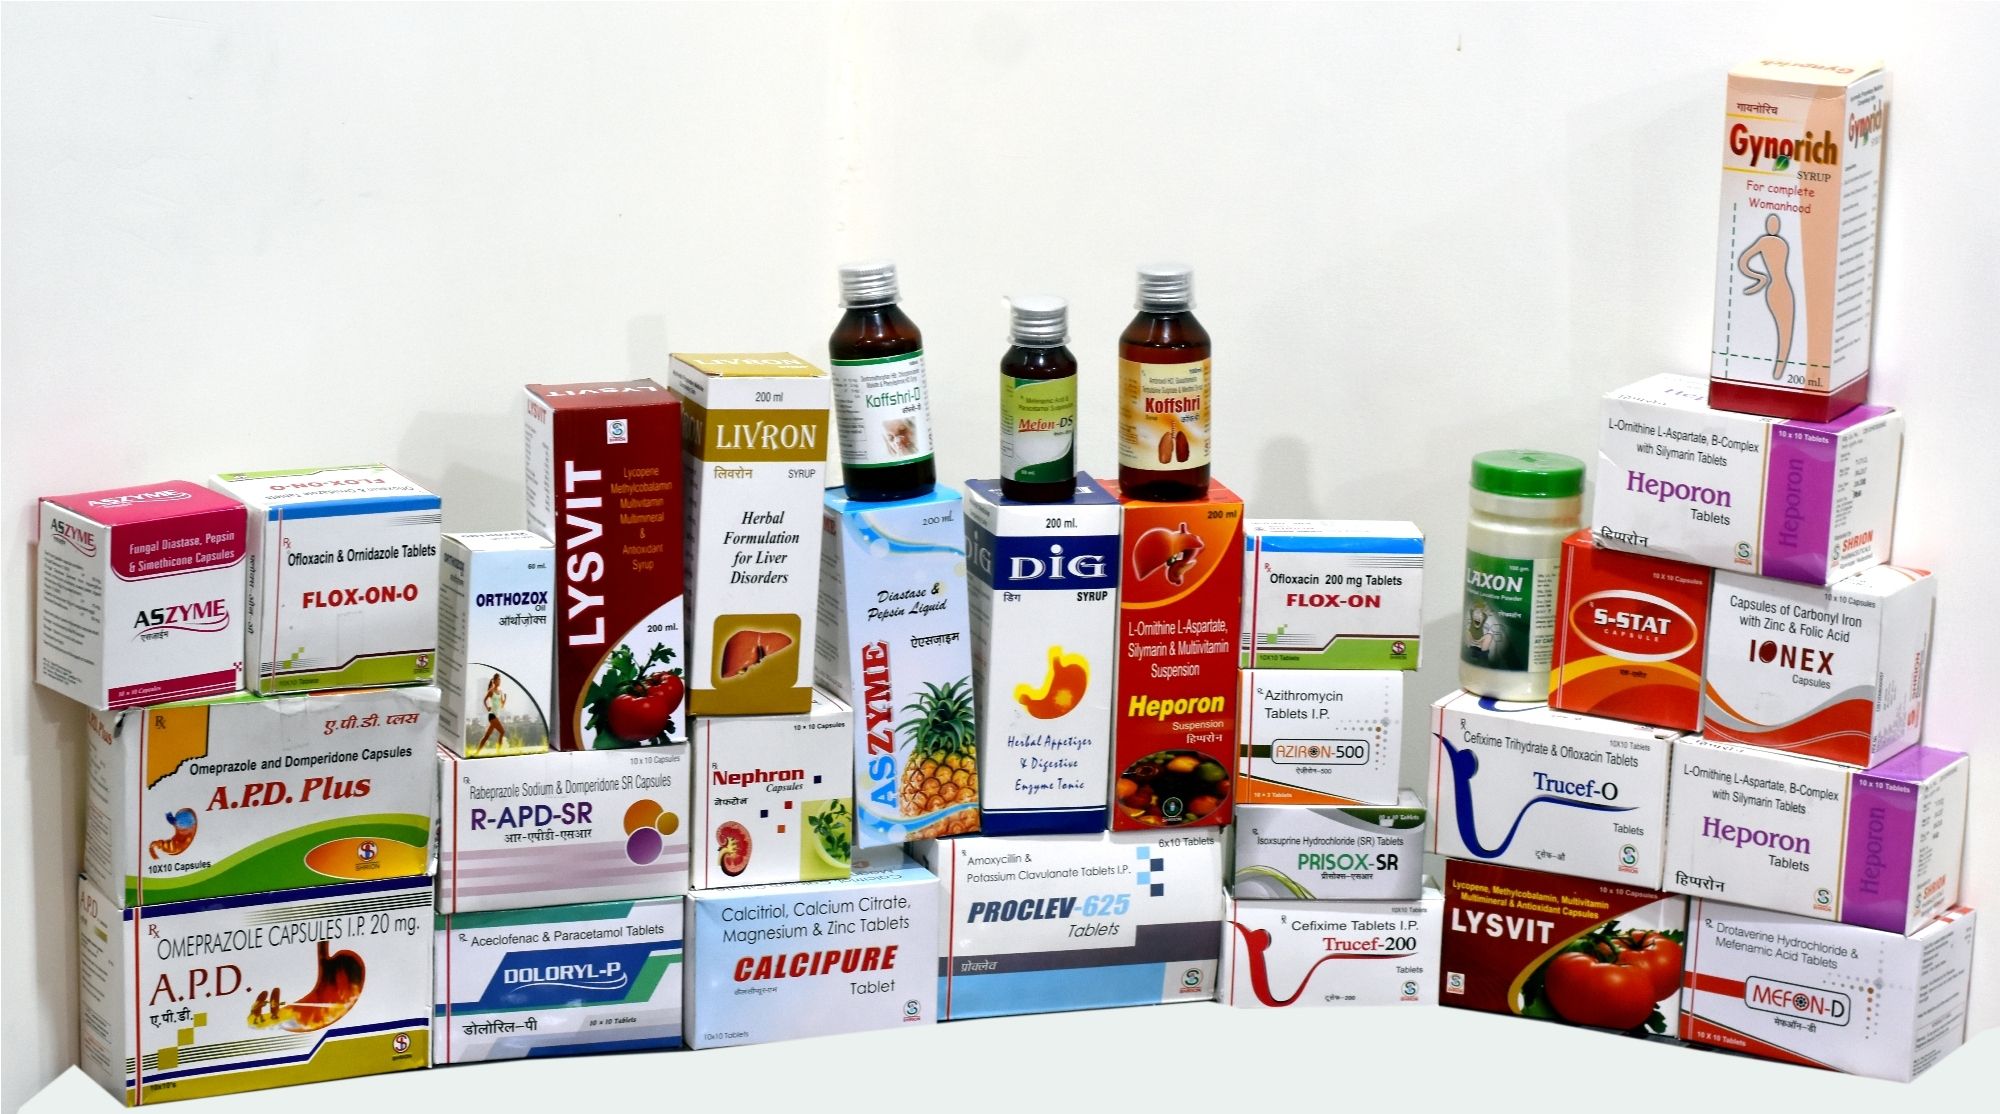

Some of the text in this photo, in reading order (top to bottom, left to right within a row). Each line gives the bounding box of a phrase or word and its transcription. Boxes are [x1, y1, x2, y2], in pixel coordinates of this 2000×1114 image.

[1729, 123, 1838, 167] Gynorich
[1797, 171, 1831, 183] SYRUP
[1746, 180, 1815, 198] For complete
[1749, 197, 1812, 214] Womanhood
[1787, 374, 1823, 388] 200 ml.
[755, 392, 784, 402] 200 ml
[865, 386, 921, 408] Koffshri-D
[1145, 395, 1200, 413] Koffshri
[716, 419, 817, 451] LIVRON
[1636, 442, 1728, 467] with Silymarin Tablets
[623, 467, 660, 478] Lycopene
[788, 469, 816, 479] SYRUP
[1626, 470, 1732, 508] Heporon
[741, 511, 785, 525] Herbal
[1045, 518, 1078, 528] 200 ml.
[1208, 510, 1237, 519] 200 ml
[1691, 508, 1731, 526] Tablets
[129, 531, 235, 555] Fungal Diastase, Pepsin
[723, 531, 800, 545] Formulation
[288, 543, 437, 567] Ofloxacin & Ornidazole Tablets
[564, 460, 606, 646] LYSVIT
[731, 550, 788, 567] for Liver
[633, 558, 654, 571] Syrup
[730, 570, 789, 585] Disorders
[1270, 573, 1403, 587] Ofloxacin 200 mg Tablets
[303, 584, 418, 608] FLOX-ON-O
[476, 591, 548, 608] ORTHOZOX
[1077, 591, 1108, 602] SYRUP
[1286, 593, 1381, 608] FLOX-ON
[134, 599, 226, 628] ASZYME
[535, 604, 546, 612] Oil
[1730, 595, 1863, 628] Capsules of Carbonyl Iron
[647, 623, 679, 633] 200 ml.
[1128, 618, 1228, 637] L-Ornithine L-Aspartate,
[1594, 608, 1671, 635] S-STAT
[1604, 629, 1659, 642] CAPSULE
[1749, 639, 1835, 676] IONEX
[1151, 662, 1200, 680] Suspension
[1792, 674, 1831, 690] Capsules
[1265, 689, 1343, 704] Azithromycin
[1128, 695, 1225, 722] Heporon
[1265, 707, 1330, 719] Tablets I.P.
[862, 639, 898, 809] ASZYME
[1172, 720, 1224, 731] Suspension
[189, 745, 413, 776] Omeprazole and Domperidone Capsules
[1275, 745, 1364, 759] AZIRON-500
[713, 768, 805, 788] Nephron
[1015, 777, 1085, 795] Enzyme Tonic
[1533, 771, 1618, 801] Trucef-O
[205, 775, 372, 812] A.P.D. Plus
[469, 774, 671, 801] Rabeprazole Sodium & Domperidone SR Capsules
[766, 782, 803, 794] Capsules
[1712, 789, 1806, 815] with Silymarin Tablets
[471, 801, 593, 830] R-APD-SR
[1612, 822, 1644, 836] Tablets
[1702, 816, 1811, 855] Heporon
[1158, 836, 1215, 848] 6x10 Tablets
[1257, 836, 1404, 847] Isoxsuprine Hydrochloride (SR) Tablets
[148, 859, 212, 874] 10X10 Capsules
[967, 853, 1032, 866] Amoxycillin &
[1297, 853, 1399, 871] PRISOX-SR
[1768, 854, 1810, 873] Tablets
[967, 864, 1132, 884] Potassium Clavulanate Tablets I.P.
[721, 895, 911, 922] Calcitriol, Calcium Citrate,
[967, 893, 1131, 924] PROCLEV-625
[722, 915, 910, 944] Magnesium & Zinc Tablets
[1068, 922, 1120, 939] Tablets
[1291, 920, 1419, 932] Cefixime Tablets I.P.
[1451, 907, 1555, 944] LYSVIT
[471, 924, 664, 947] Aceclofenac & Paracetamol Tablets
[1323, 936, 1417, 951] Trucef-200
[1716, 922, 1859, 959] Drotaverine Hydrochloride &
[1715, 936, 1838, 970] Mefenamic Acid Tablets
[504, 961, 622, 984] DOLORYL-P
[733, 944, 899, 983] CALCIPURE
[1396, 966, 1423, 974] Tablets
[149, 964, 252, 1006] A.P.D.
[850, 979, 896, 995] Tablet
[1752, 984, 1845, 1018] MEFON-D
[724, 1030, 749, 1039] Tablets
